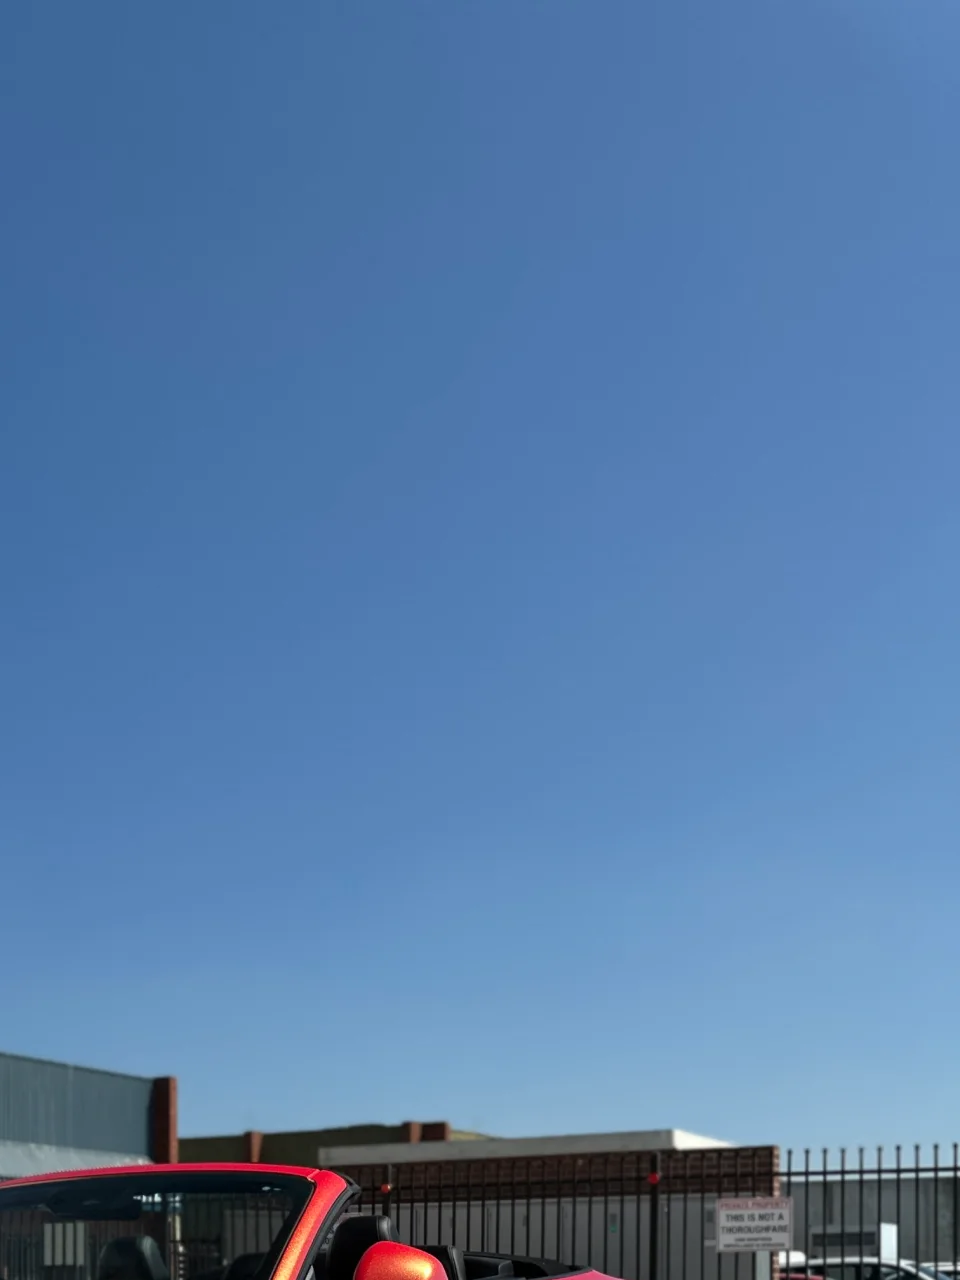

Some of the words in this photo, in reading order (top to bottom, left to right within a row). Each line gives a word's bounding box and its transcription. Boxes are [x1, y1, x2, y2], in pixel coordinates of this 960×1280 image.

[725, 1213, 745, 1222] THIS
[747, 1213, 756, 1222] IS
[758, 1212, 775, 1221] NOT
[777, 1212, 785, 1221] A
[721, 1224, 789, 1235] THOROUGHFARE
